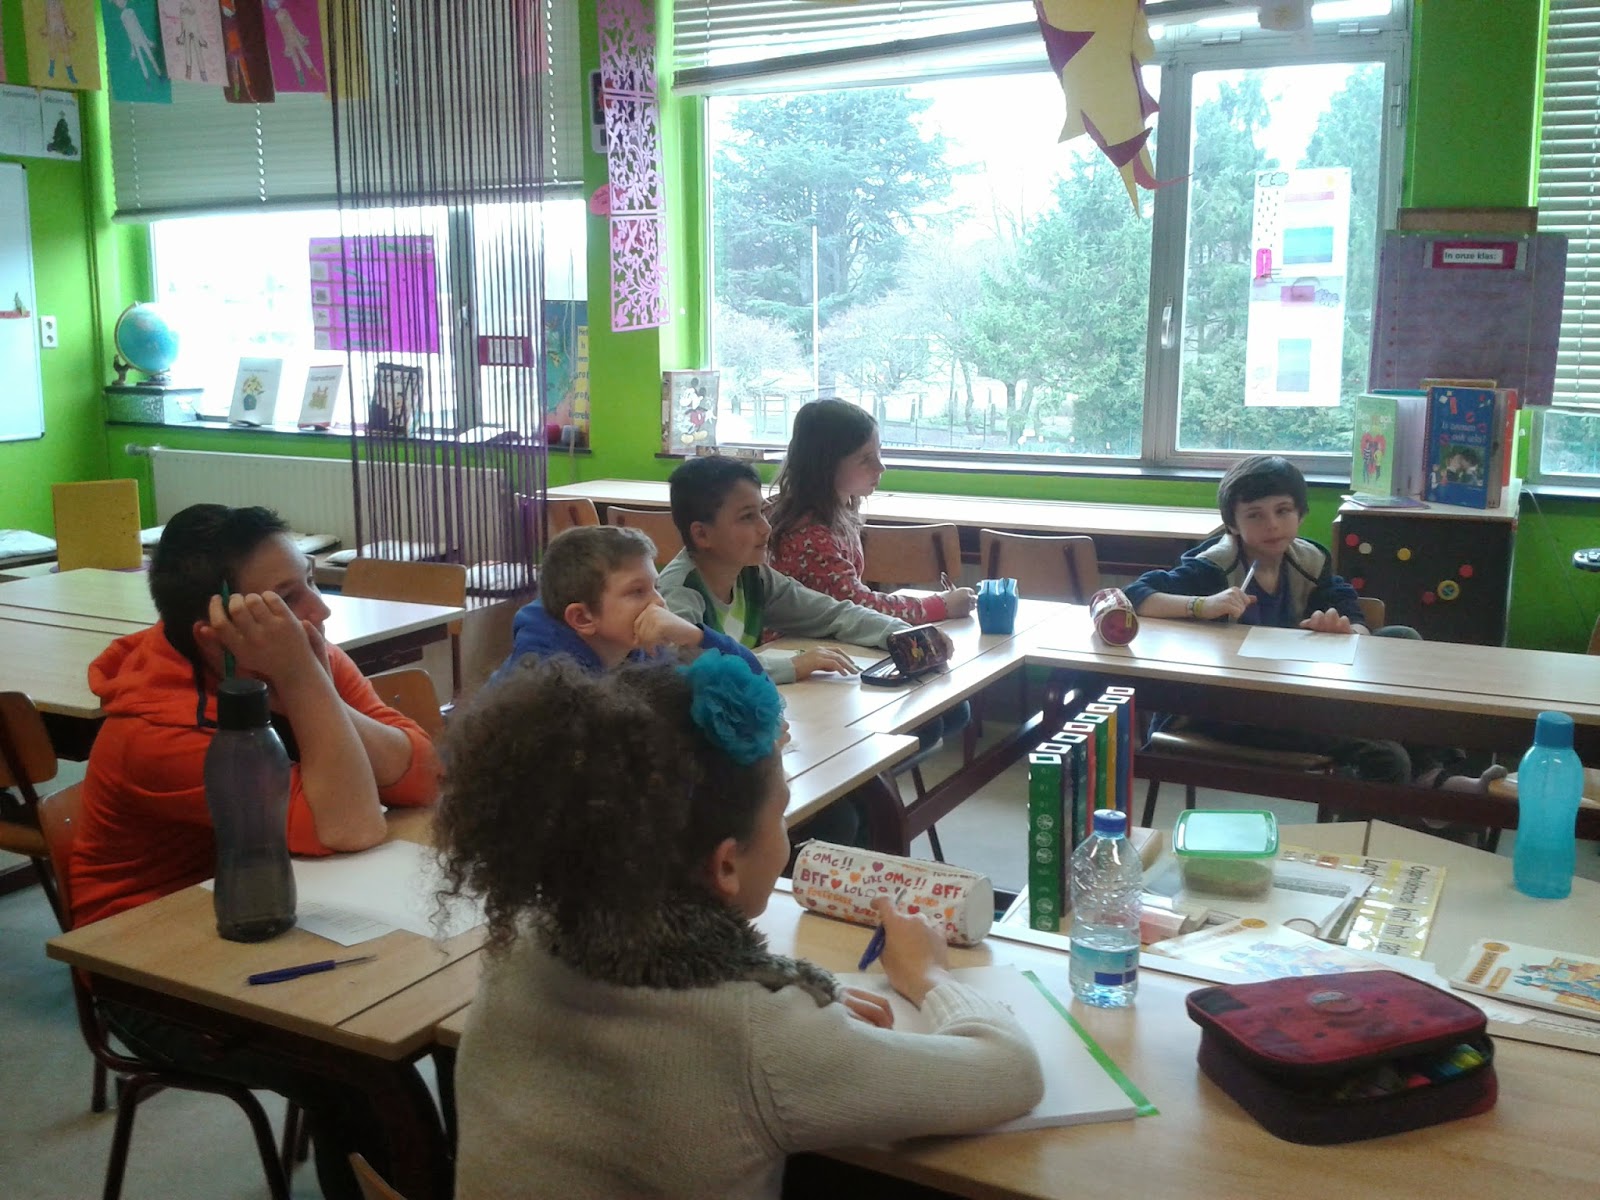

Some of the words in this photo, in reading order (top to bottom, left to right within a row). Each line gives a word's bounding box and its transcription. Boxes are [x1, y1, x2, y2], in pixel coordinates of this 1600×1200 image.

[1477, 251, 1497, 260] klas:
[800, 868, 830, 888] BFF
[844, 884, 863, 897] LOL
[931, 883, 962, 899] BFF
